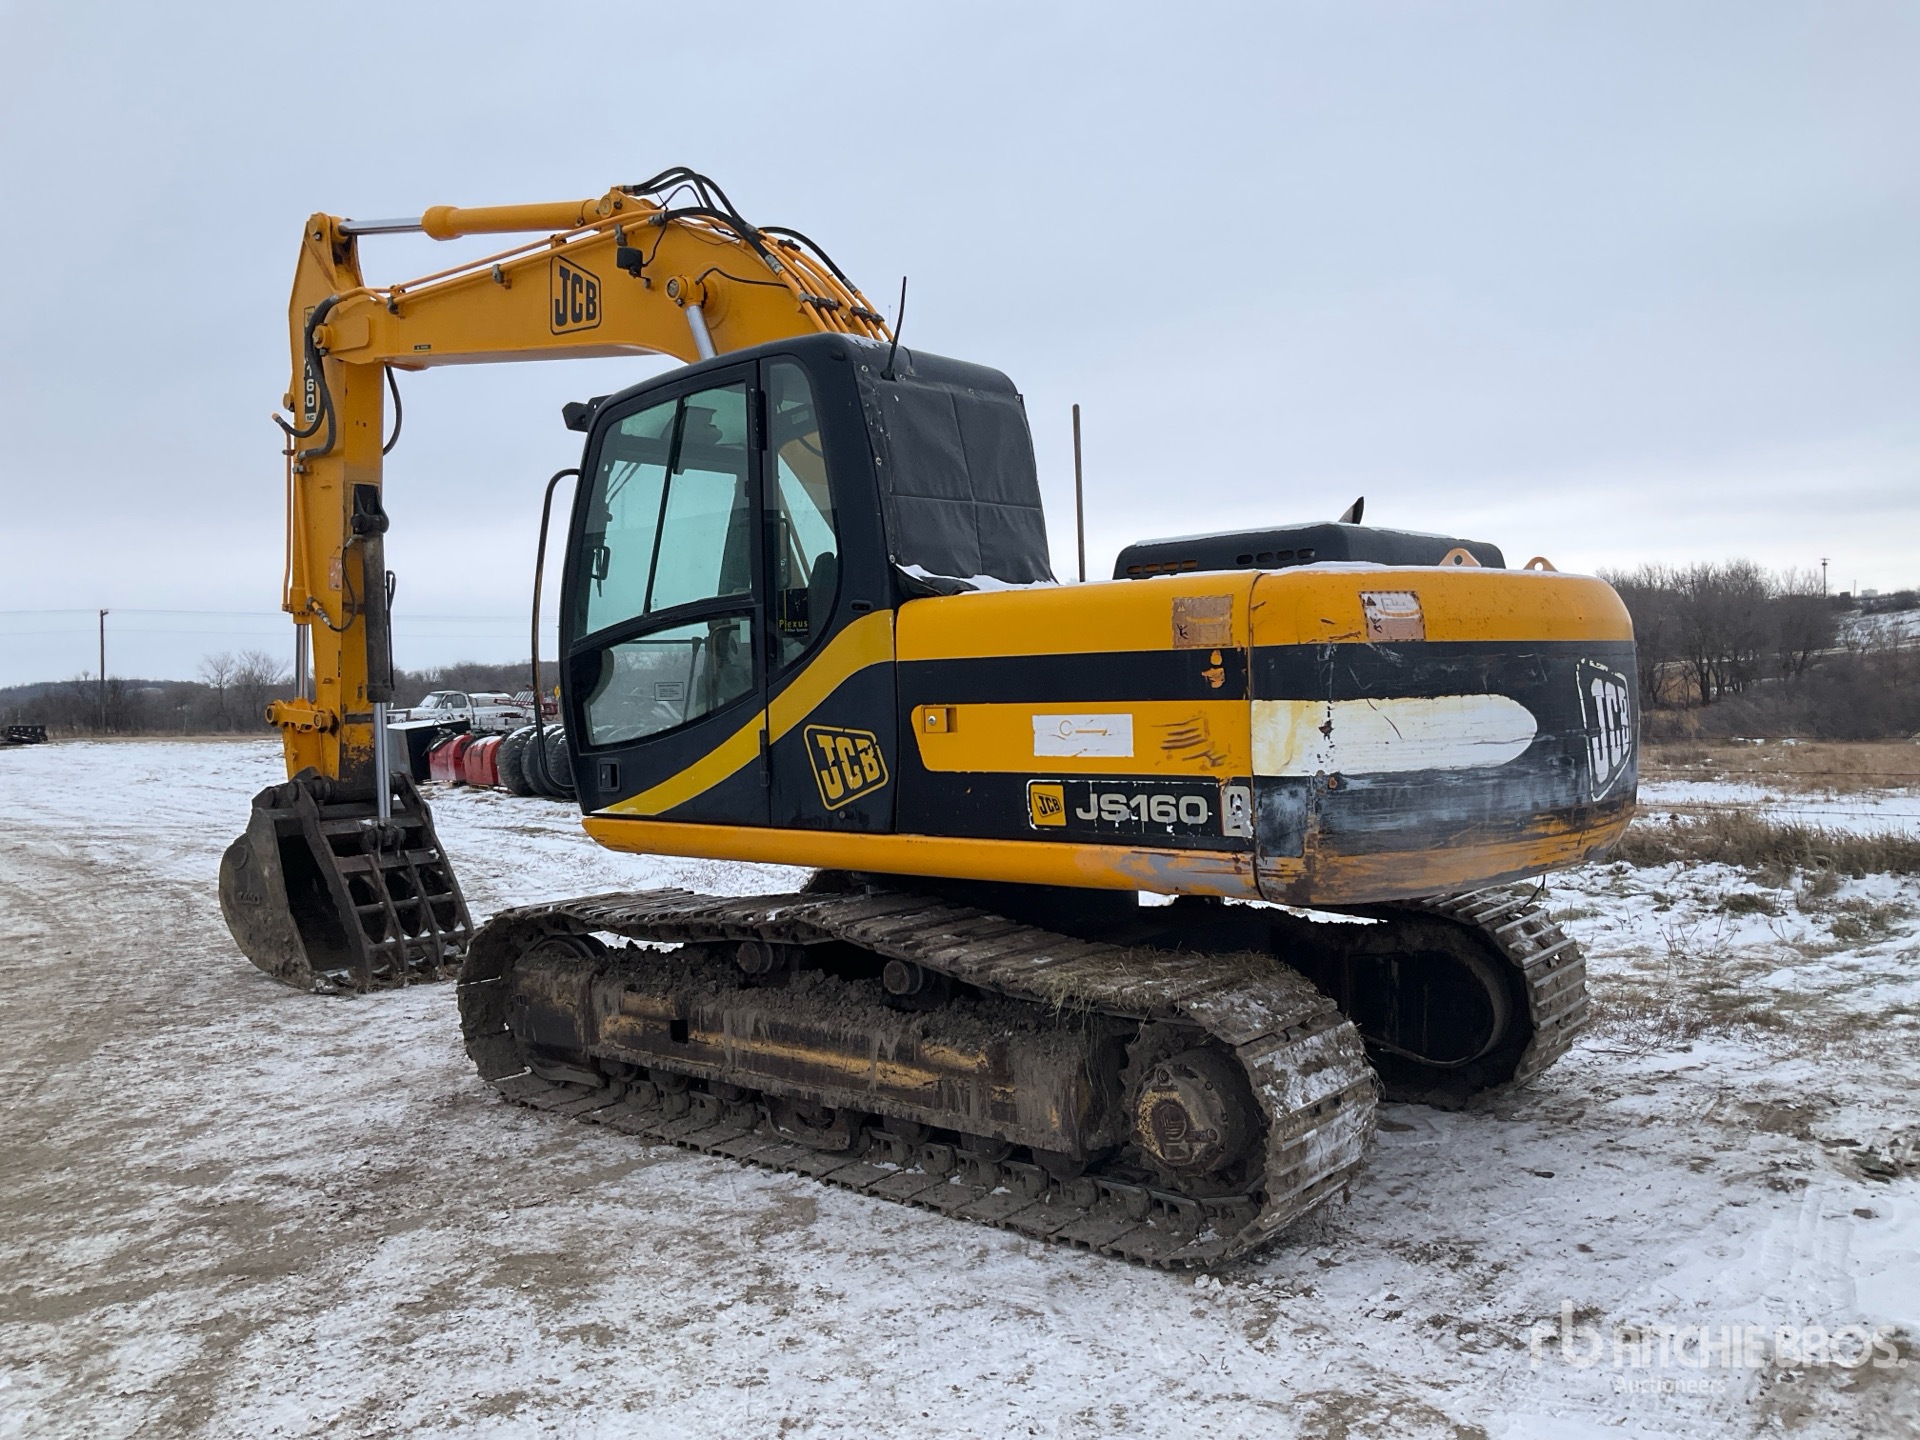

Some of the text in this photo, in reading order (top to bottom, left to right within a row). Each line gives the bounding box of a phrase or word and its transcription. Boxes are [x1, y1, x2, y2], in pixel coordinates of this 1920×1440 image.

[555, 264, 597, 327] JCB
[779, 619, 808, 629] Plexus
[1591, 677, 1629, 784] JCB
[816, 734, 881, 800] JCB
[1038, 795, 1061, 815] JCB
[1075, 793, 1209, 825] JS160
